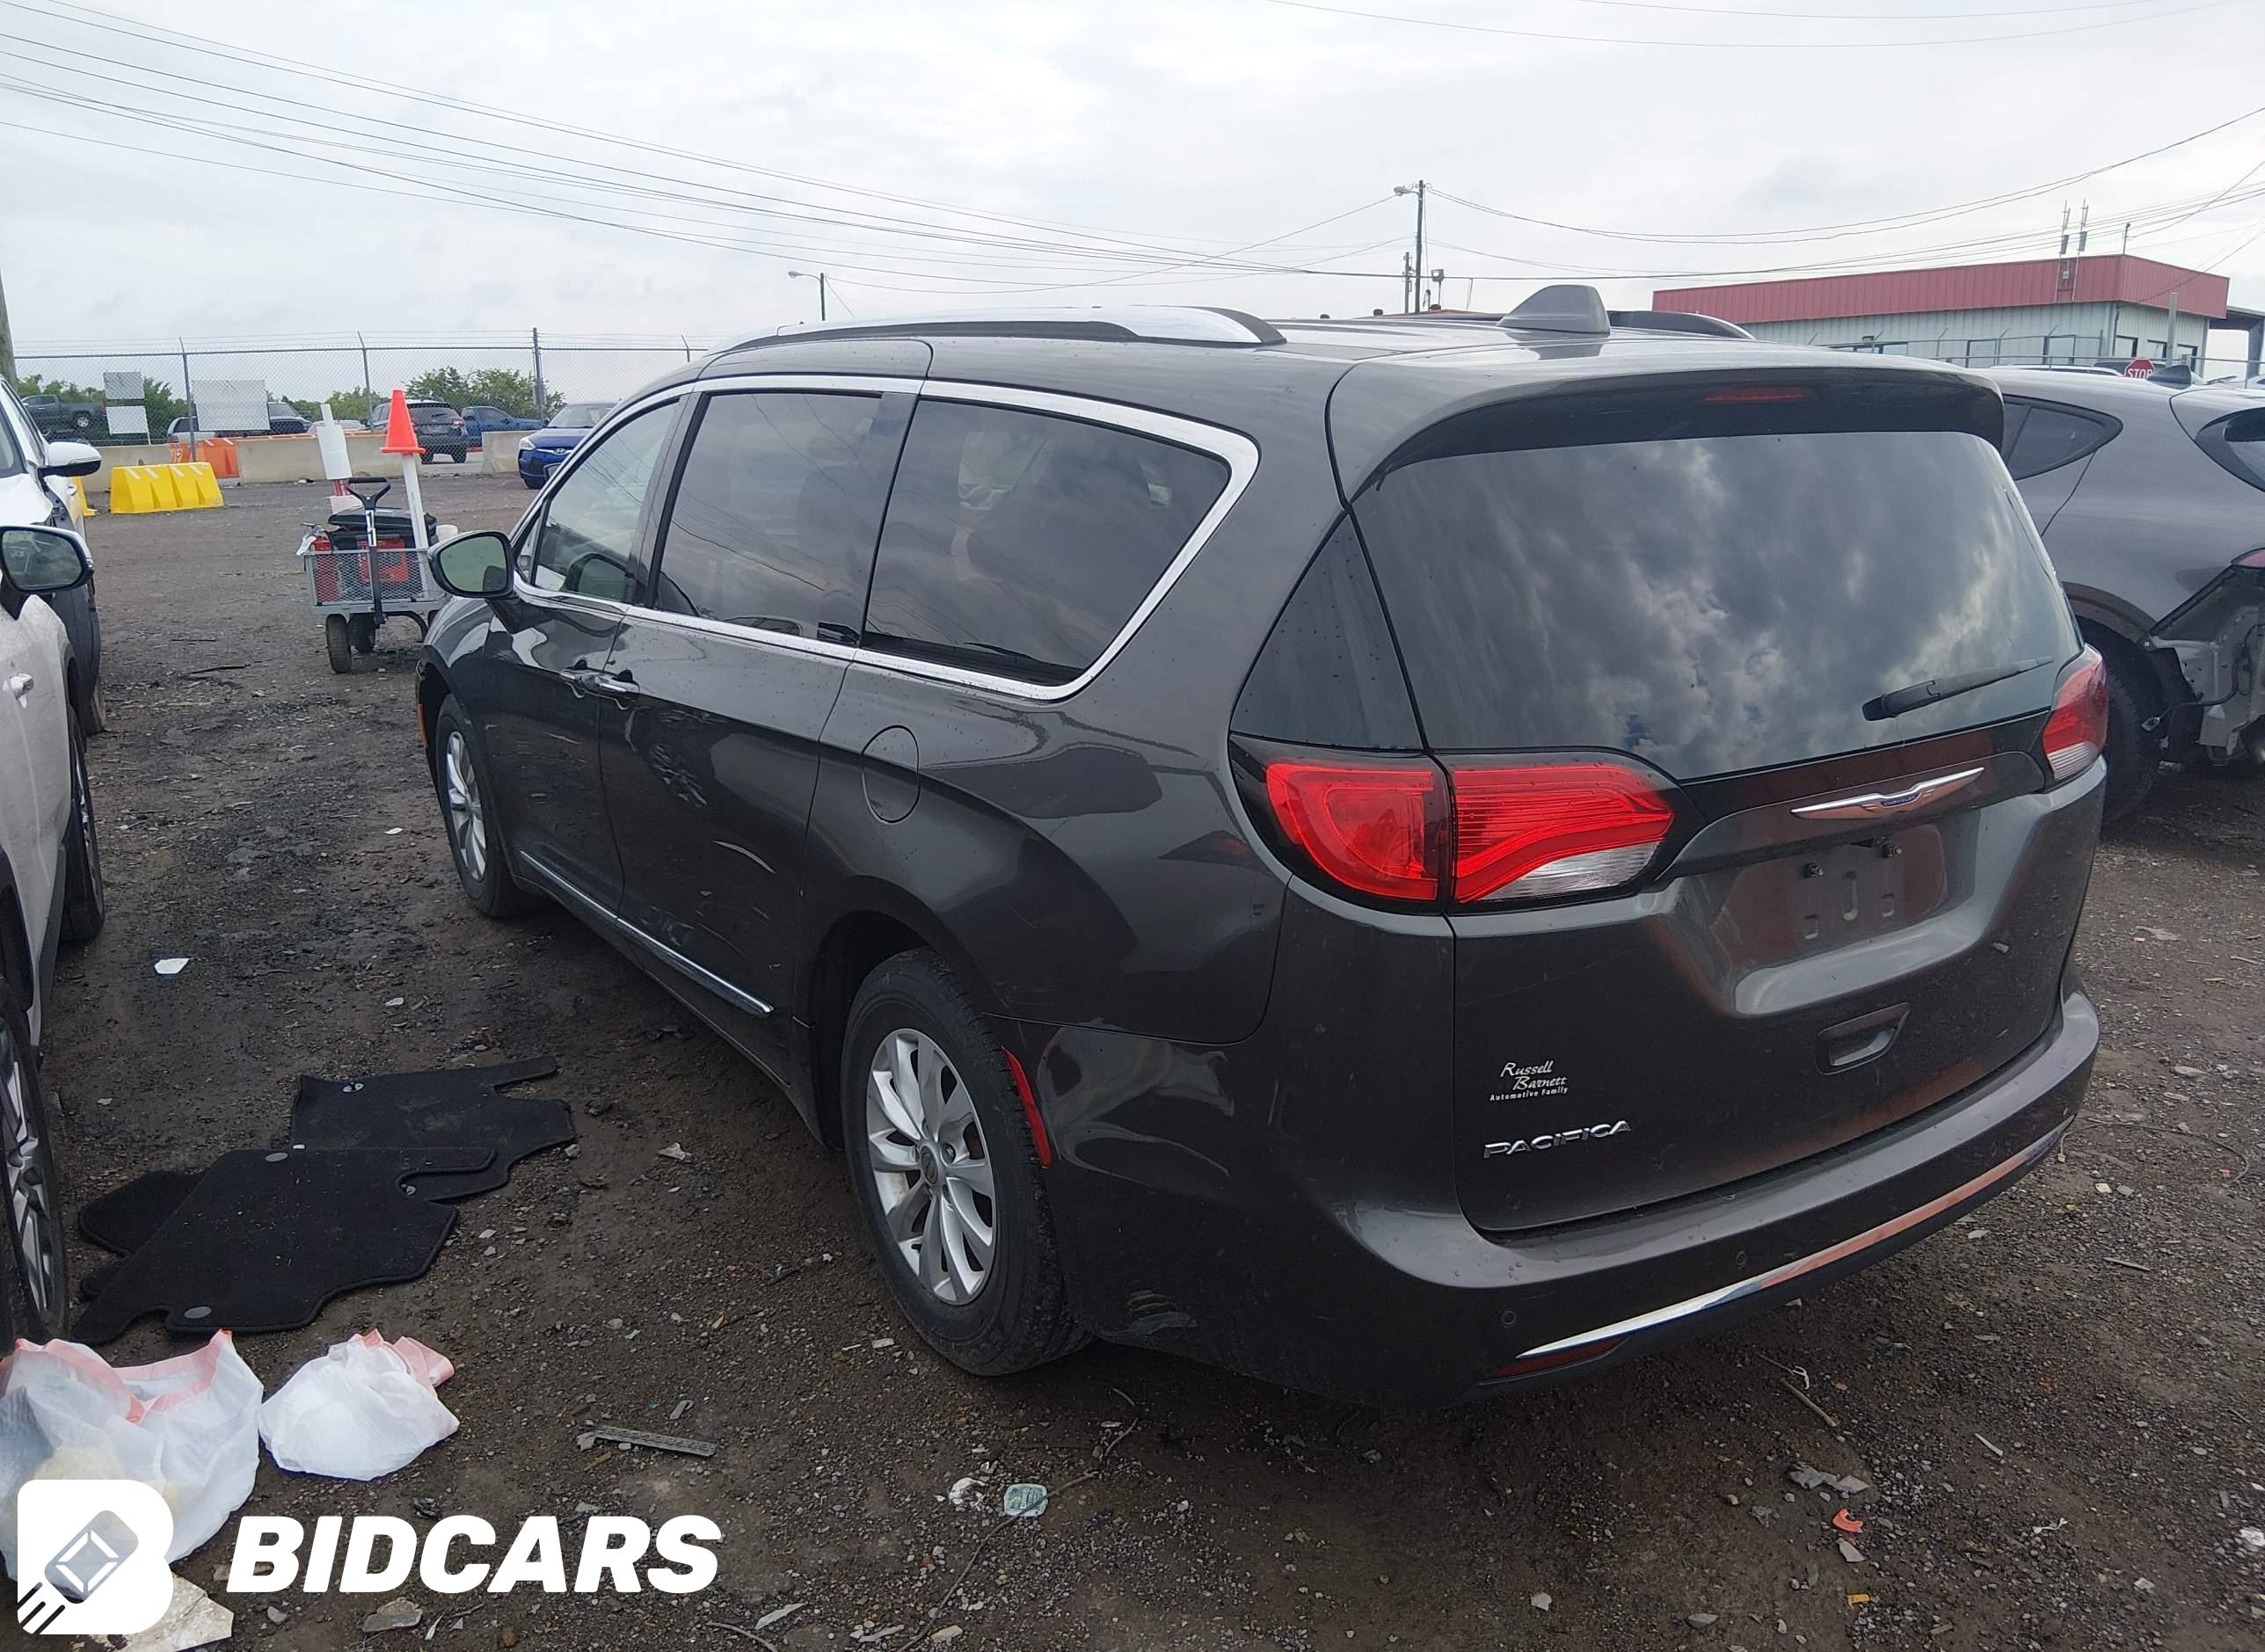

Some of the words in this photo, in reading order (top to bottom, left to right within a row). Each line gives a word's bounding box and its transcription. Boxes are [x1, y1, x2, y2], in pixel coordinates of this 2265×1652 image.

[2128, 368, 2153, 380] STOP
[1500, 1060, 1554, 1077] Russell
[1512, 1076, 1568, 1090] Barnett
[1489, 1090, 1539, 1101] Automotive
[1541, 1086, 1568, 1095] Family
[1483, 1120, 1631, 1159] PACIFICA
